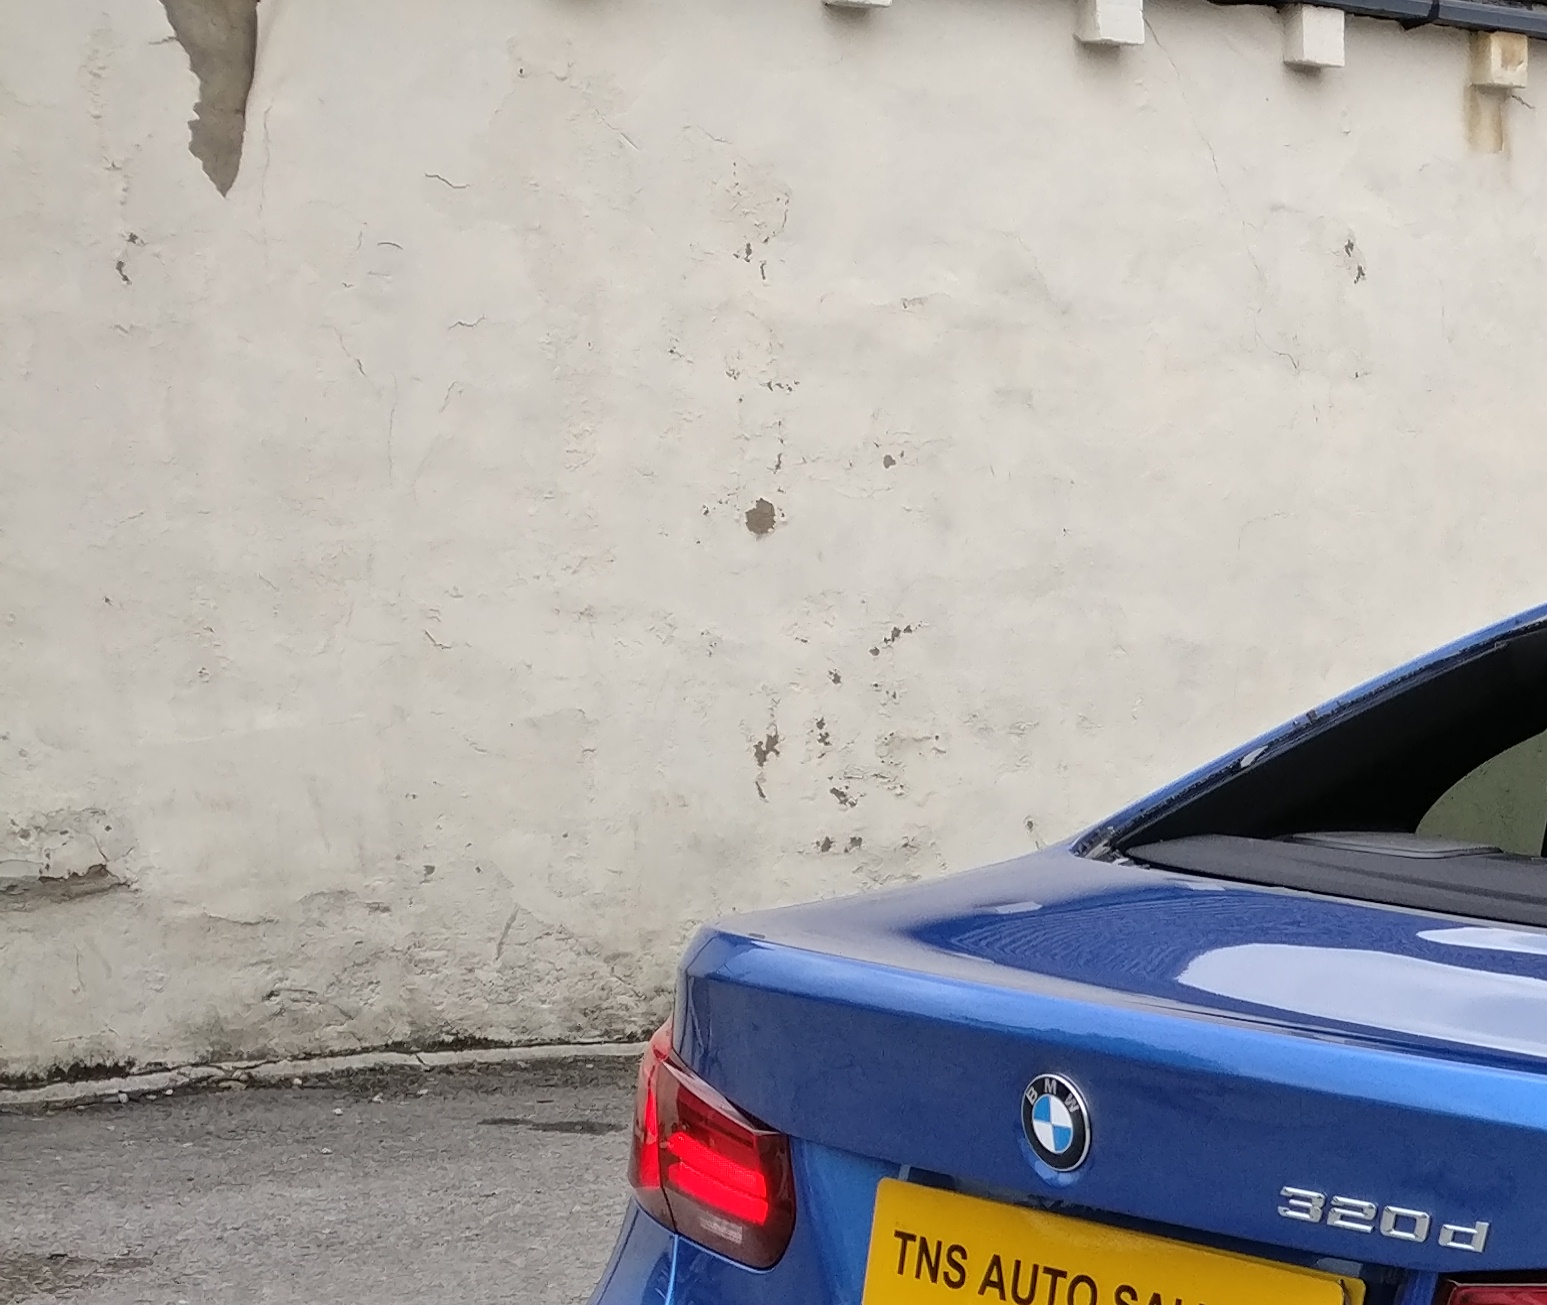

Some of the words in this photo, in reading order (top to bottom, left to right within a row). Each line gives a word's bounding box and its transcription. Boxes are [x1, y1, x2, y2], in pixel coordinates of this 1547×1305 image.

[1025, 1077, 1080, 1113] BMW
[1279, 1185, 1490, 1254] 320d
[893, 1229, 968, 1290] TNS
